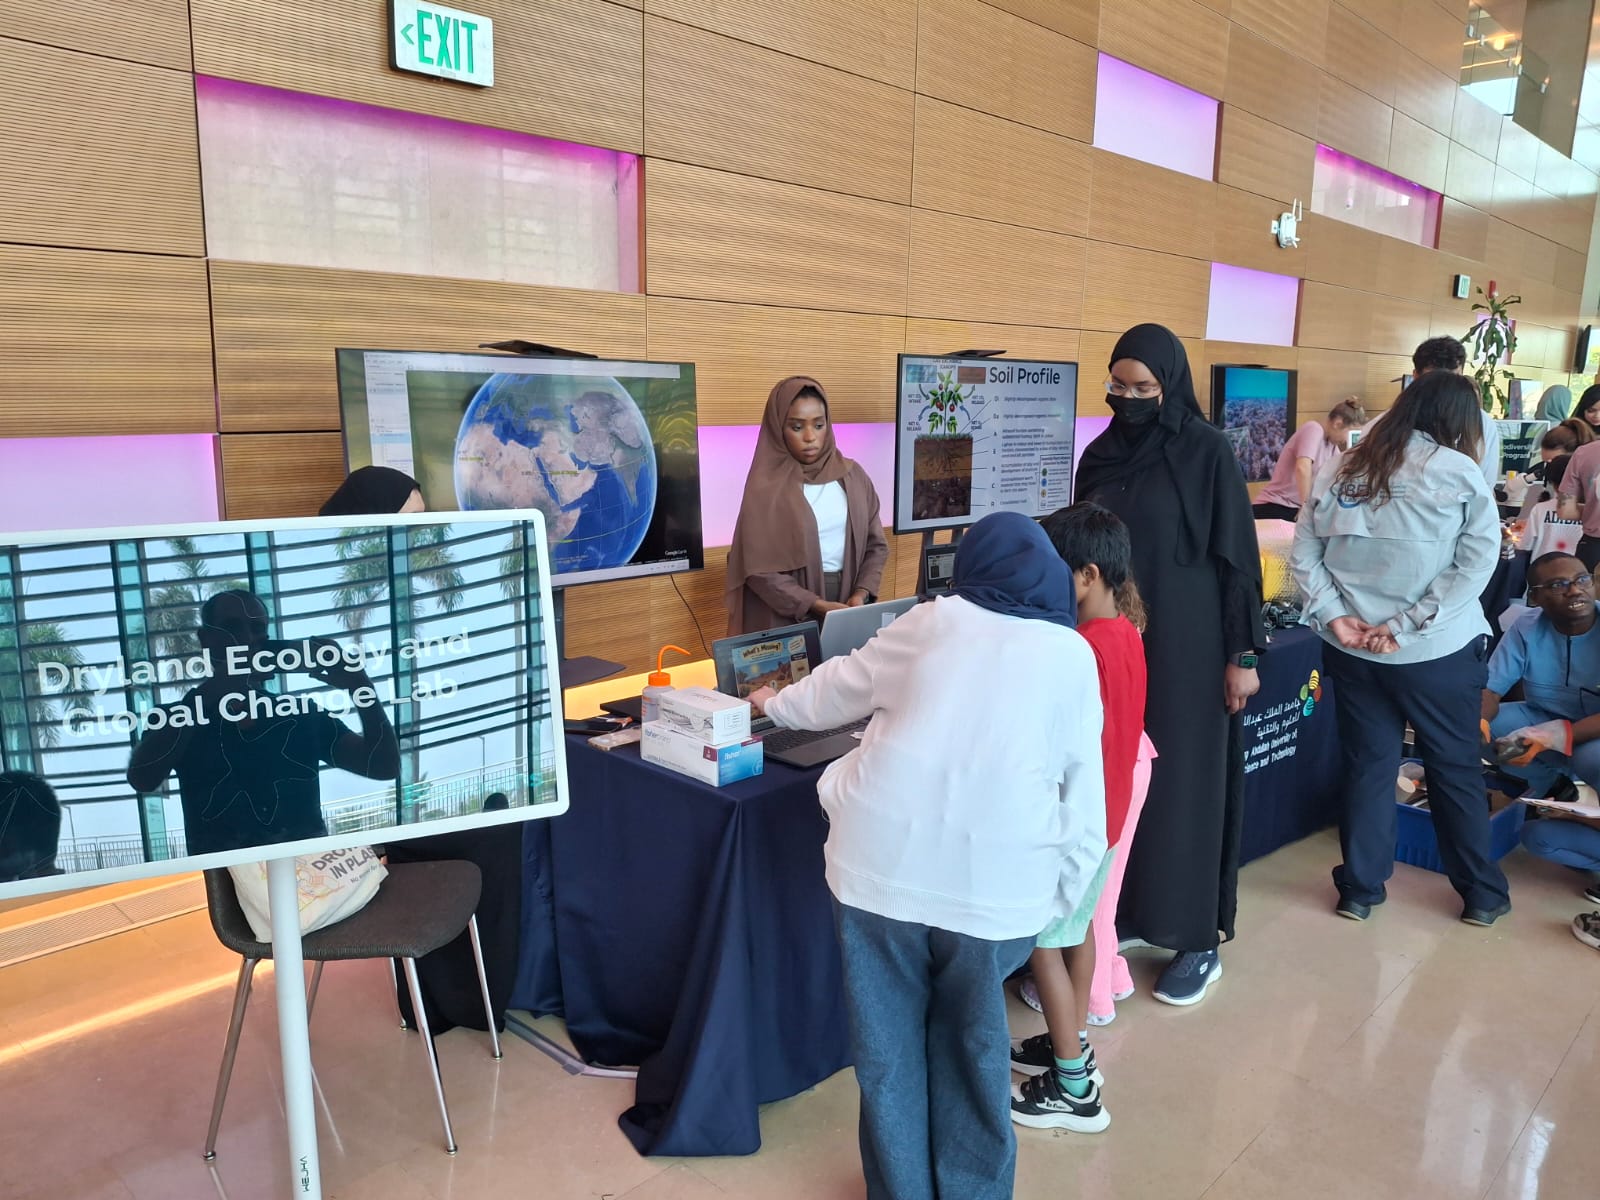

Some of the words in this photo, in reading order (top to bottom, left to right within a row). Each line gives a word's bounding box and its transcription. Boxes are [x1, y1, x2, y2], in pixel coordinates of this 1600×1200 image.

[416, 9, 478, 74] EXIT
[989, 365, 1014, 384] Soil
[1017, 367, 1060, 385] Profile
[37, 648, 214, 697] Dryland
[226, 639, 389, 672] Ecology
[399, 627, 470, 660] and
[62, 695, 210, 738] Global
[218, 685, 377, 722] Change
[388, 672, 459, 704] Lab
[1264, 703, 1283, 719] الملك
[1284, 697, 1301, 712] جامعة
[1257, 721, 1280, 740] والتقنية
[1281, 711, 1300, 732] للعلوم
[329, 862, 348, 880] IN
